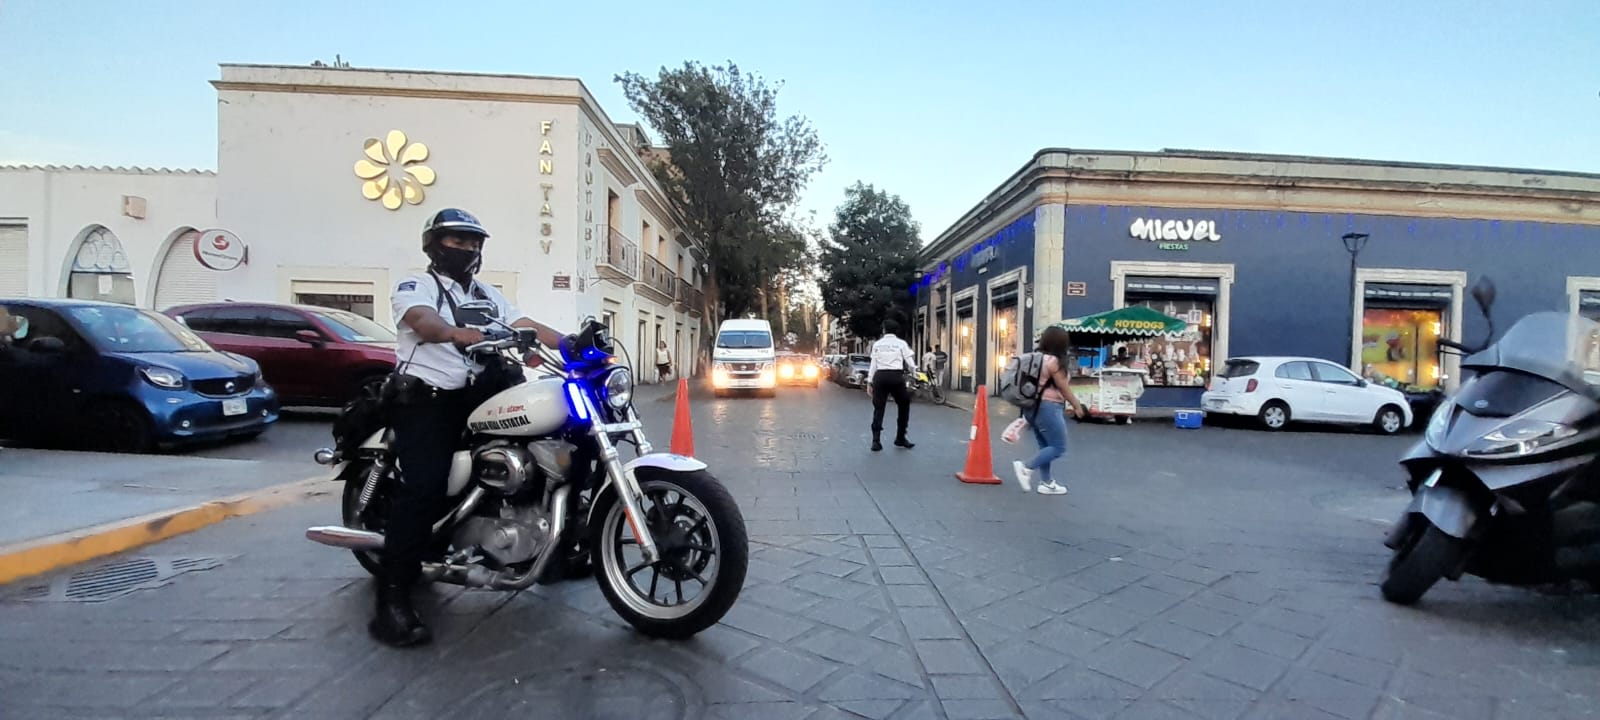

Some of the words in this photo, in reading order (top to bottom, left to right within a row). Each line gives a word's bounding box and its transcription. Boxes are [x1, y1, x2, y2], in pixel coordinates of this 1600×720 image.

[1130, 218, 1221, 241] MIGUEL
[1159, 243, 1189, 251] FIESTAS
[1115, 320, 1165, 329] HOTDOGS
[498, 414, 531, 430] ESTATAL
